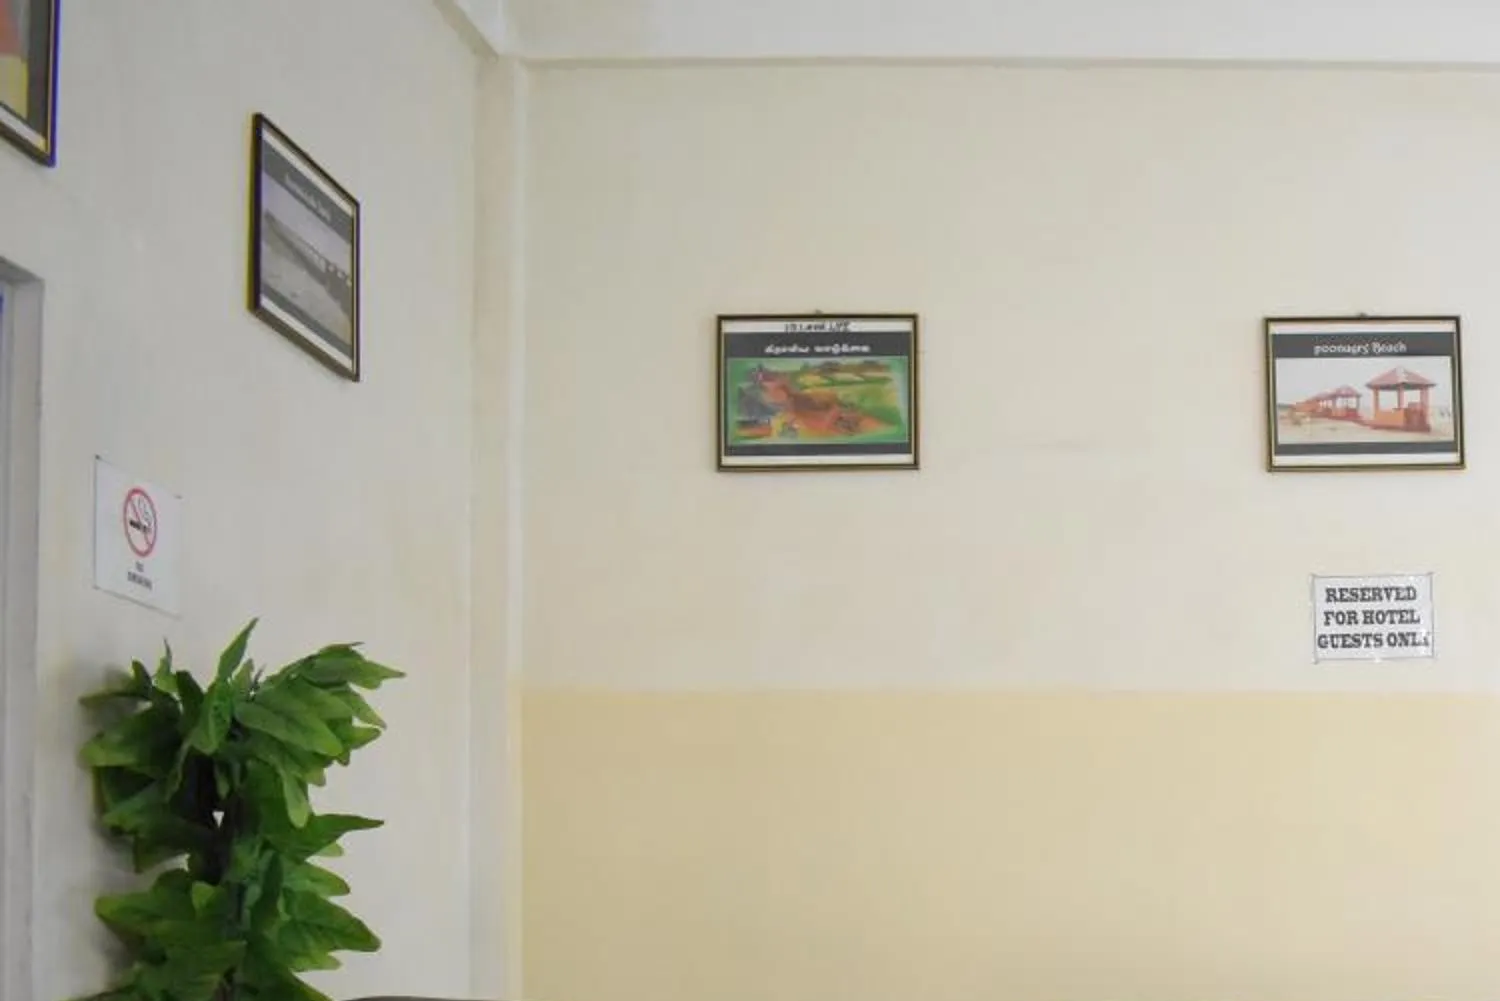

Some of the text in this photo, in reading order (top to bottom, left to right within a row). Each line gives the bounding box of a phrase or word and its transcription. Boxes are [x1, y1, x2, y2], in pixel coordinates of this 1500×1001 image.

[1325, 586, 1417, 602] RESERVED
[1323, 609, 1420, 626] FOR HOTEL
[1317, 633, 1384, 648] GUESTS
